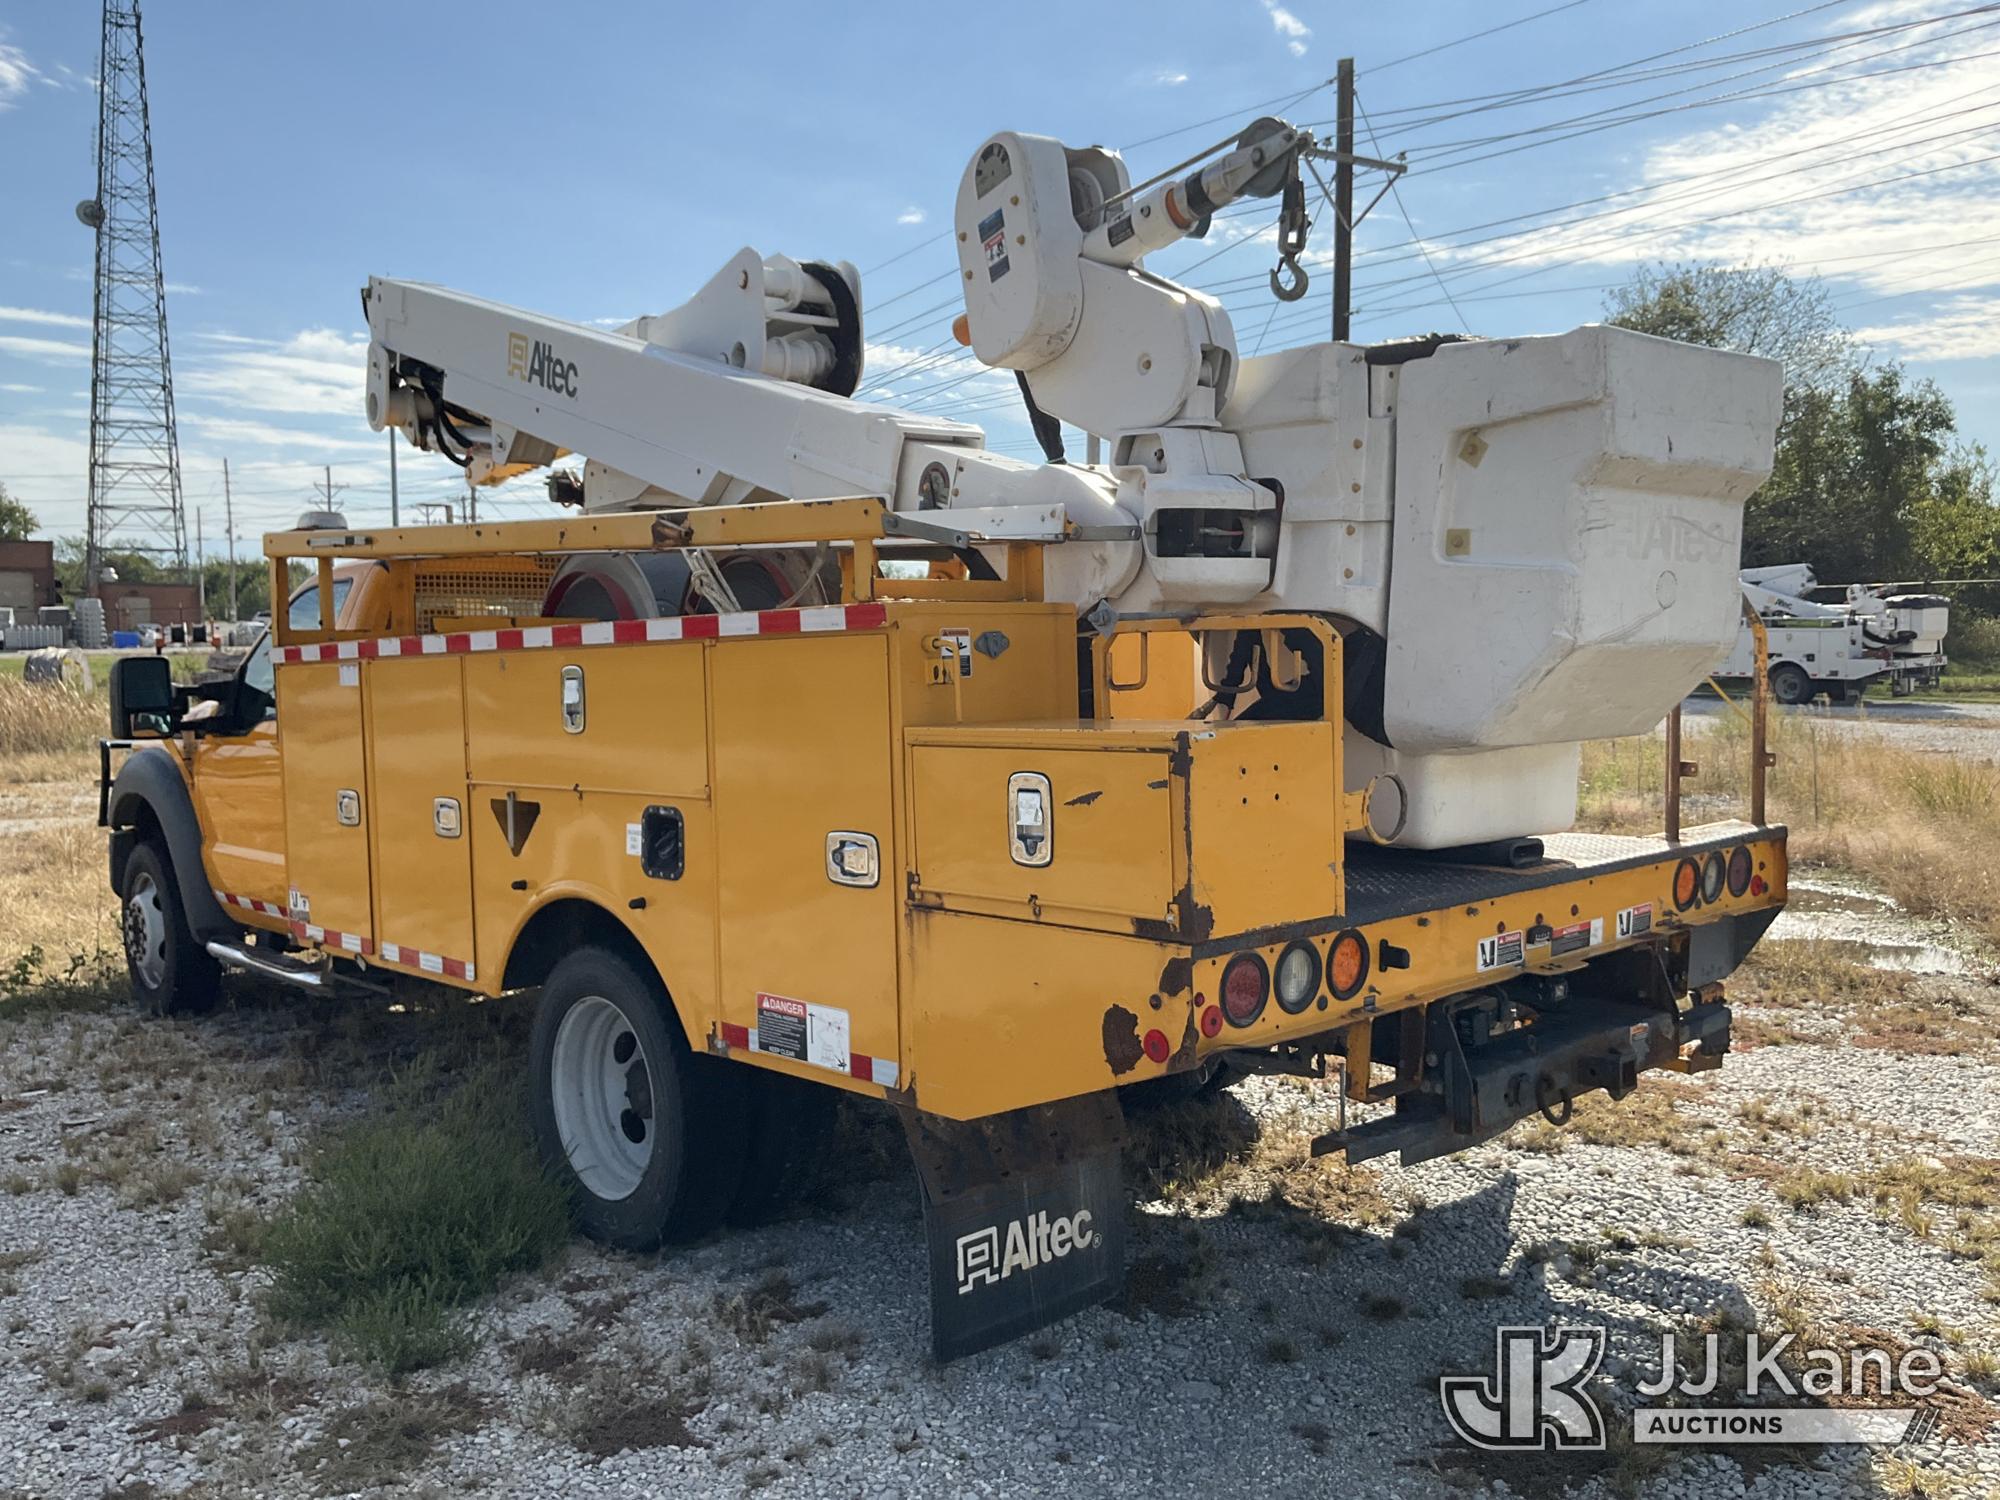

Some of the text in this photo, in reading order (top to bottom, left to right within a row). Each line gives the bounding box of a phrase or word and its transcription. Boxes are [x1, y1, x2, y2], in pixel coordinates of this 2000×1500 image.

[528, 340, 578, 398] Altec
[769, 998, 804, 1016] DANGER
[780, 1048, 796, 1058] CLEAR
